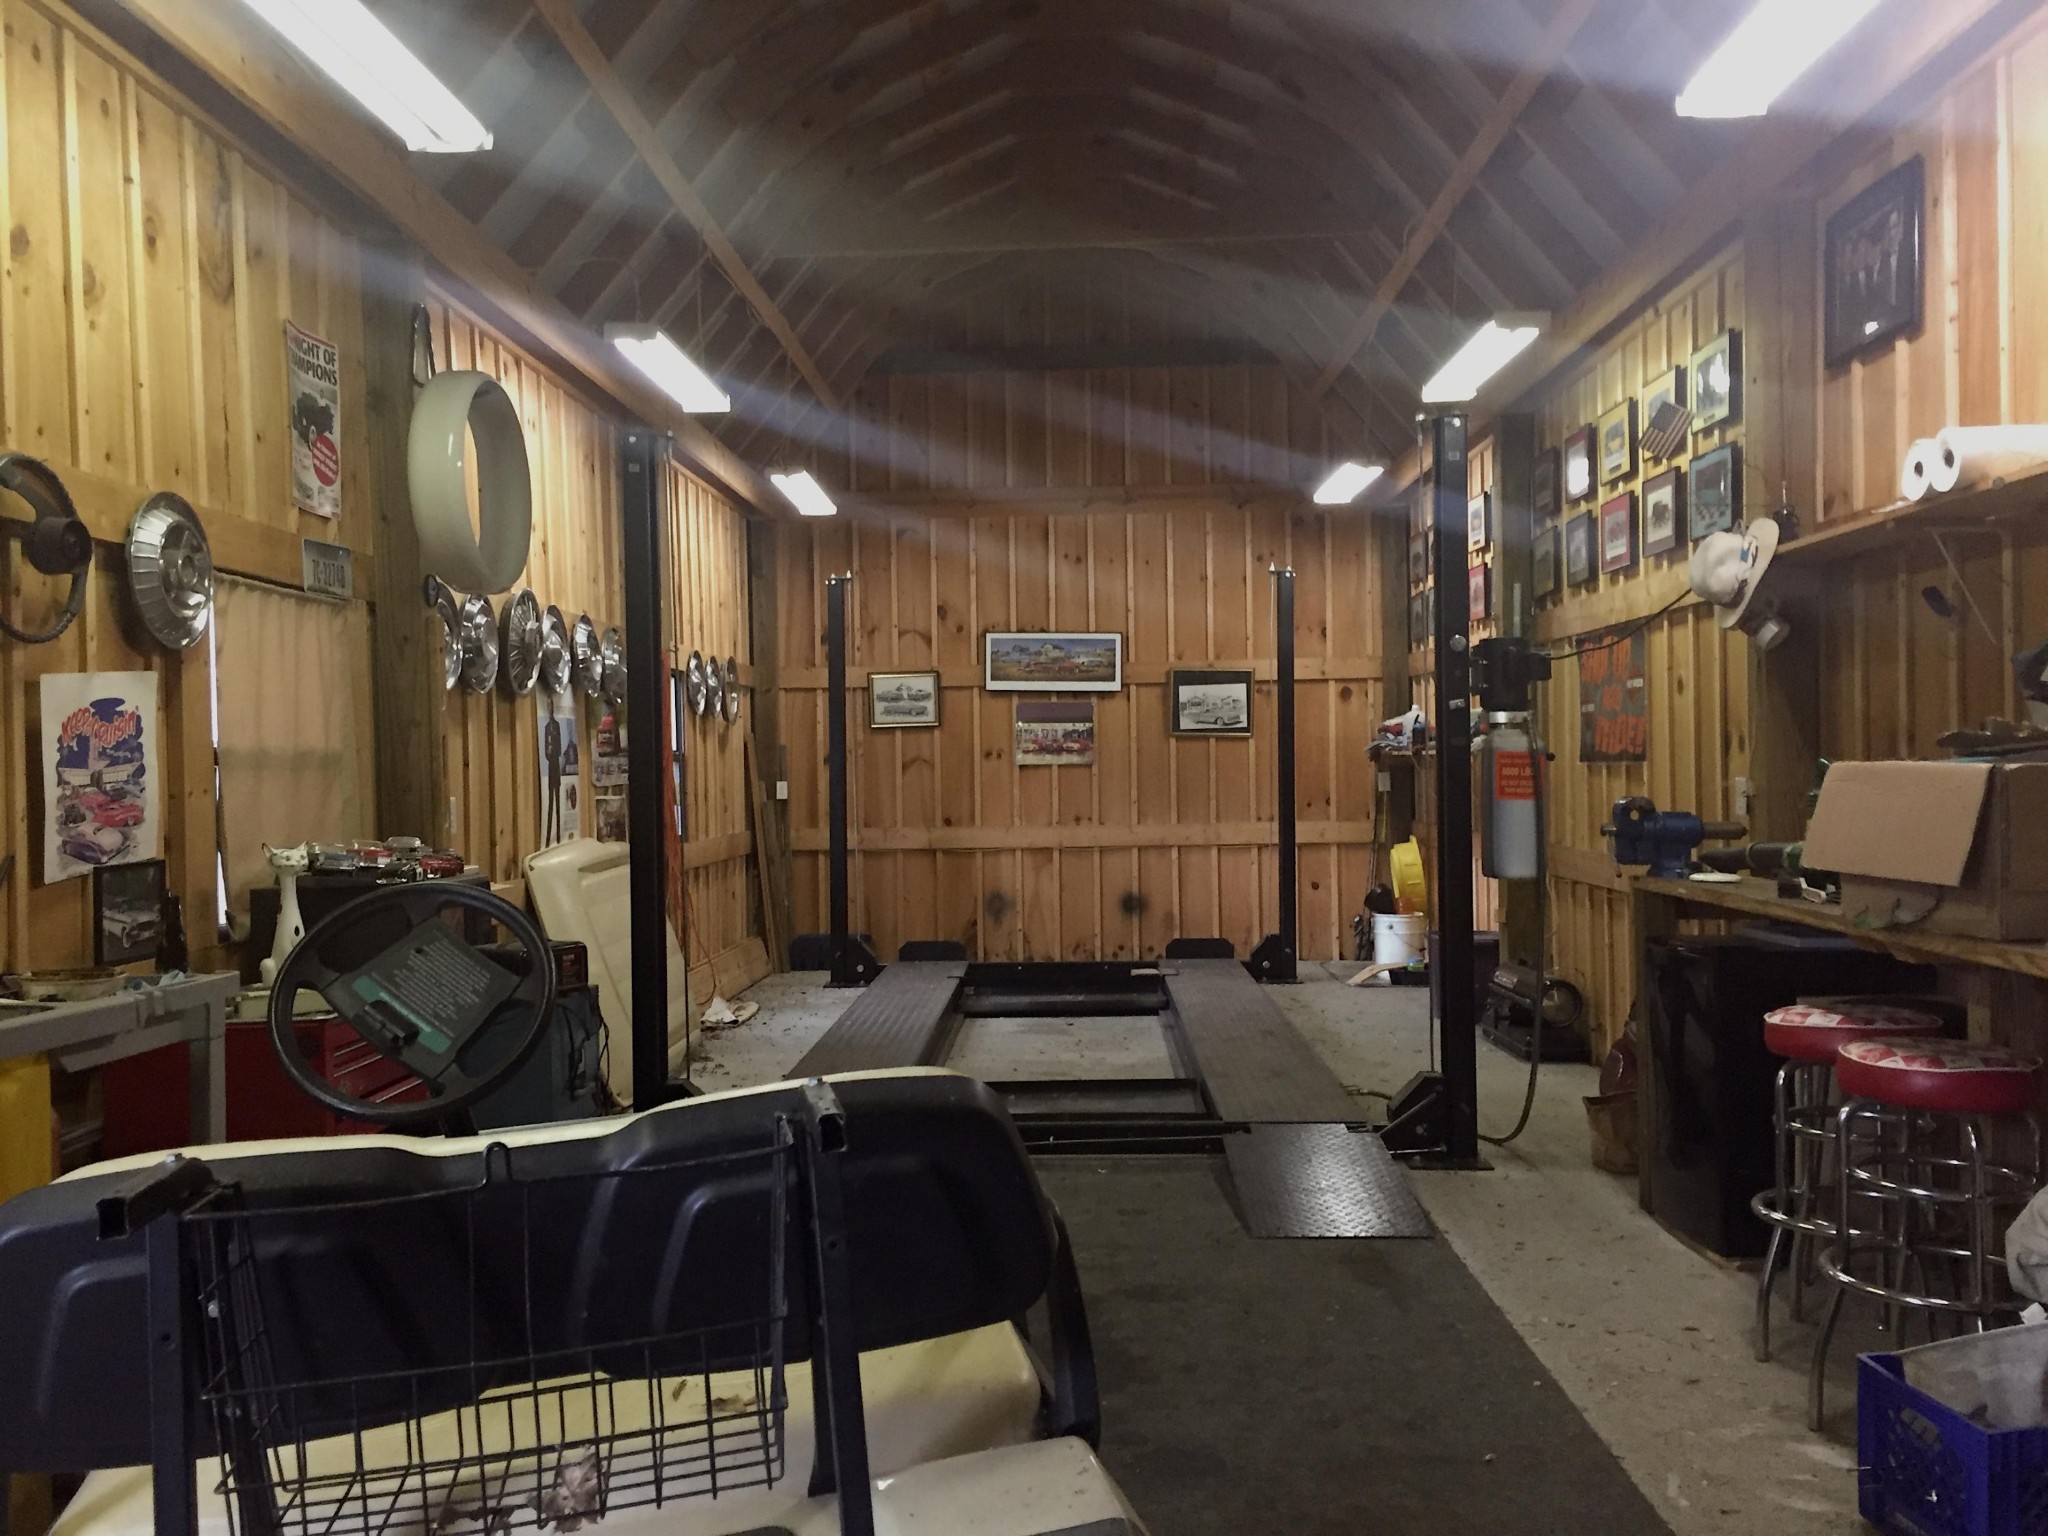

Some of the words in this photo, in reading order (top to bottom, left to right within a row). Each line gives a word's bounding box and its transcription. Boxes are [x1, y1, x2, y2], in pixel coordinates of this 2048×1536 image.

[289, 347, 338, 387] AMPIONS
[291, 336, 320, 362] IGHT
[323, 348, 336, 368] OF
